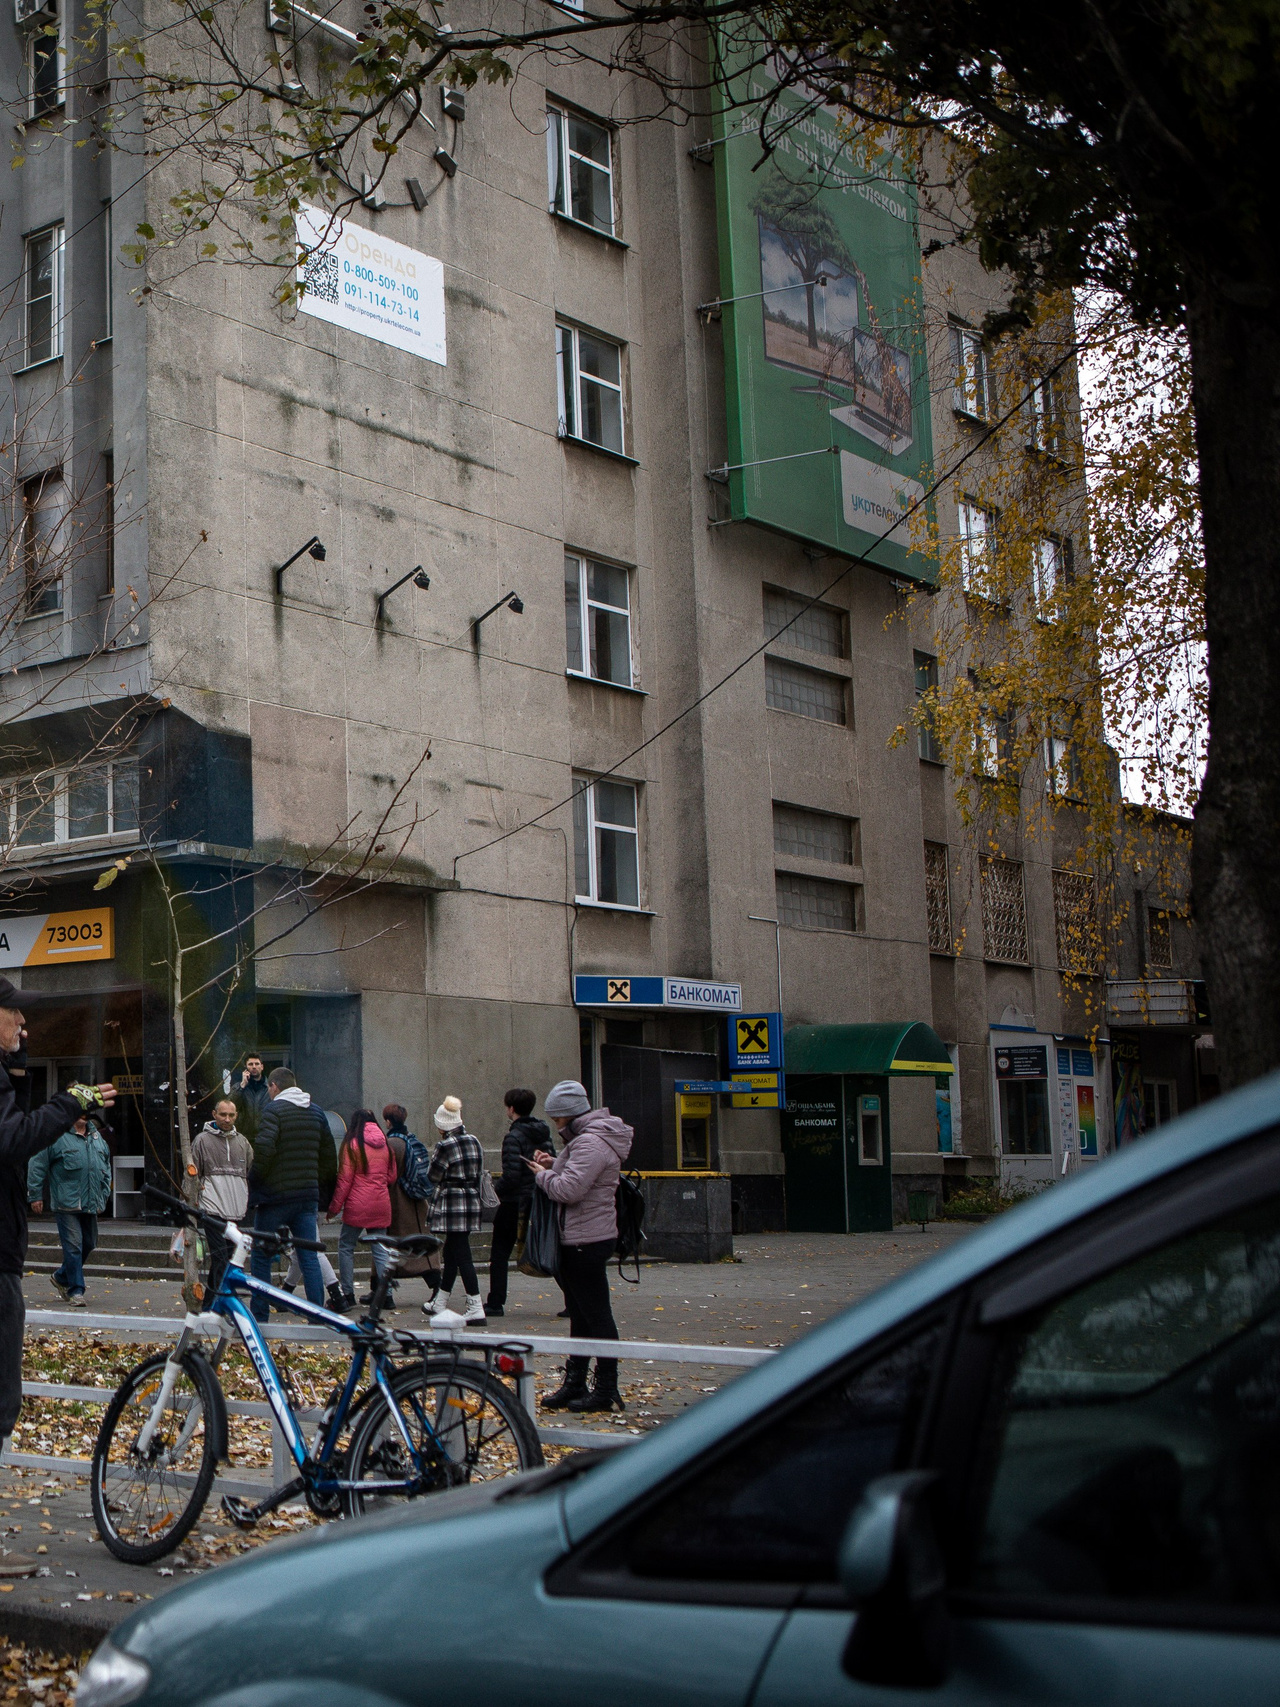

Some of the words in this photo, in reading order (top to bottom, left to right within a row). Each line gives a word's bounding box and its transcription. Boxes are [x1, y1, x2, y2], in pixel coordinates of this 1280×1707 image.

[344, 233, 417, 279] Оренда
[343, 261, 419, 302] 0-800-509-100
[344, 282, 420, 322] 091-114-73-14
[47, 922, 104, 944] 73003
[670, 984, 738, 1005] БАНКОМАТ
[245, 1329, 279, 1395] TREK
